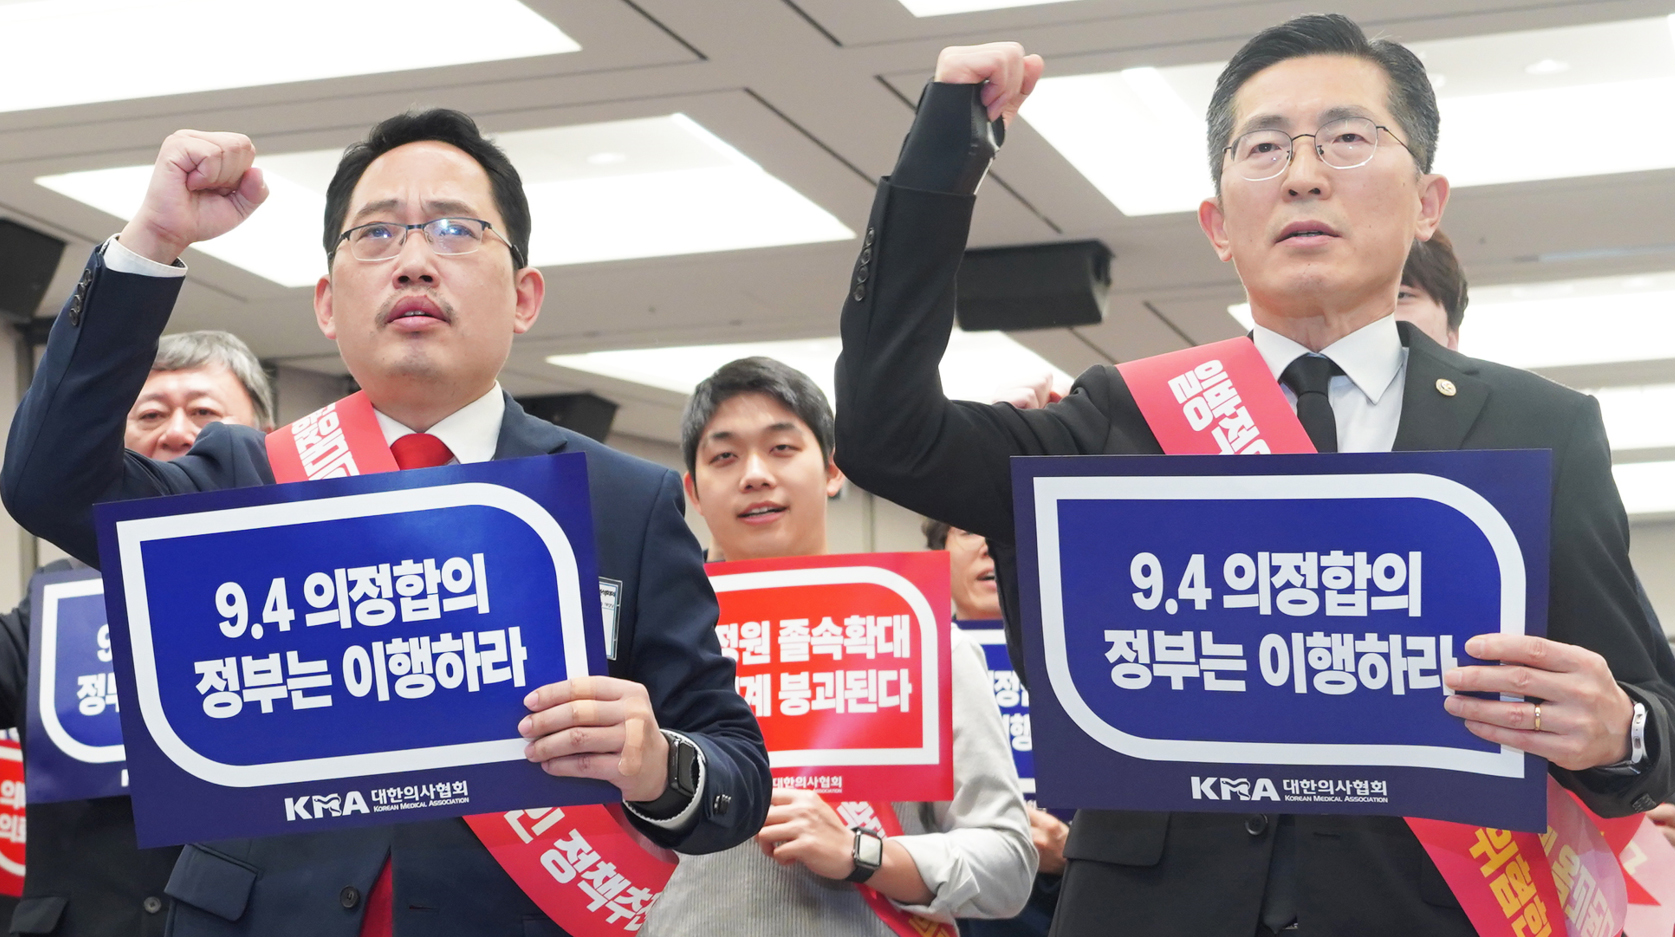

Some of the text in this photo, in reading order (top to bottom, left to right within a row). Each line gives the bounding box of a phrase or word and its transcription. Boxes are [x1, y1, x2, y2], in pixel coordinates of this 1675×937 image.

[1168, 359, 1271, 455] 일방적
[215, 552, 490, 640] 9.4 의정합의
[1131, 550, 1421, 617] 9.4 의정합의
[778, 614, 911, 663] 졸속확대
[1104, 629, 1247, 692] 정부는
[1259, 632, 1457, 696] 이행하라
[194, 626, 528, 719] 정부는 이행하라
[735, 668, 913, 718] 계 붕괴된다
[284, 791, 371, 821] KMA
[371, 780, 469, 804] 대한의사협회
[373, 797, 470, 813] KOREAN MEDICAL ASSOCIATION
[1190, 776, 1281, 801] KMA
[1283, 779, 1388, 796] 대한의사협회
